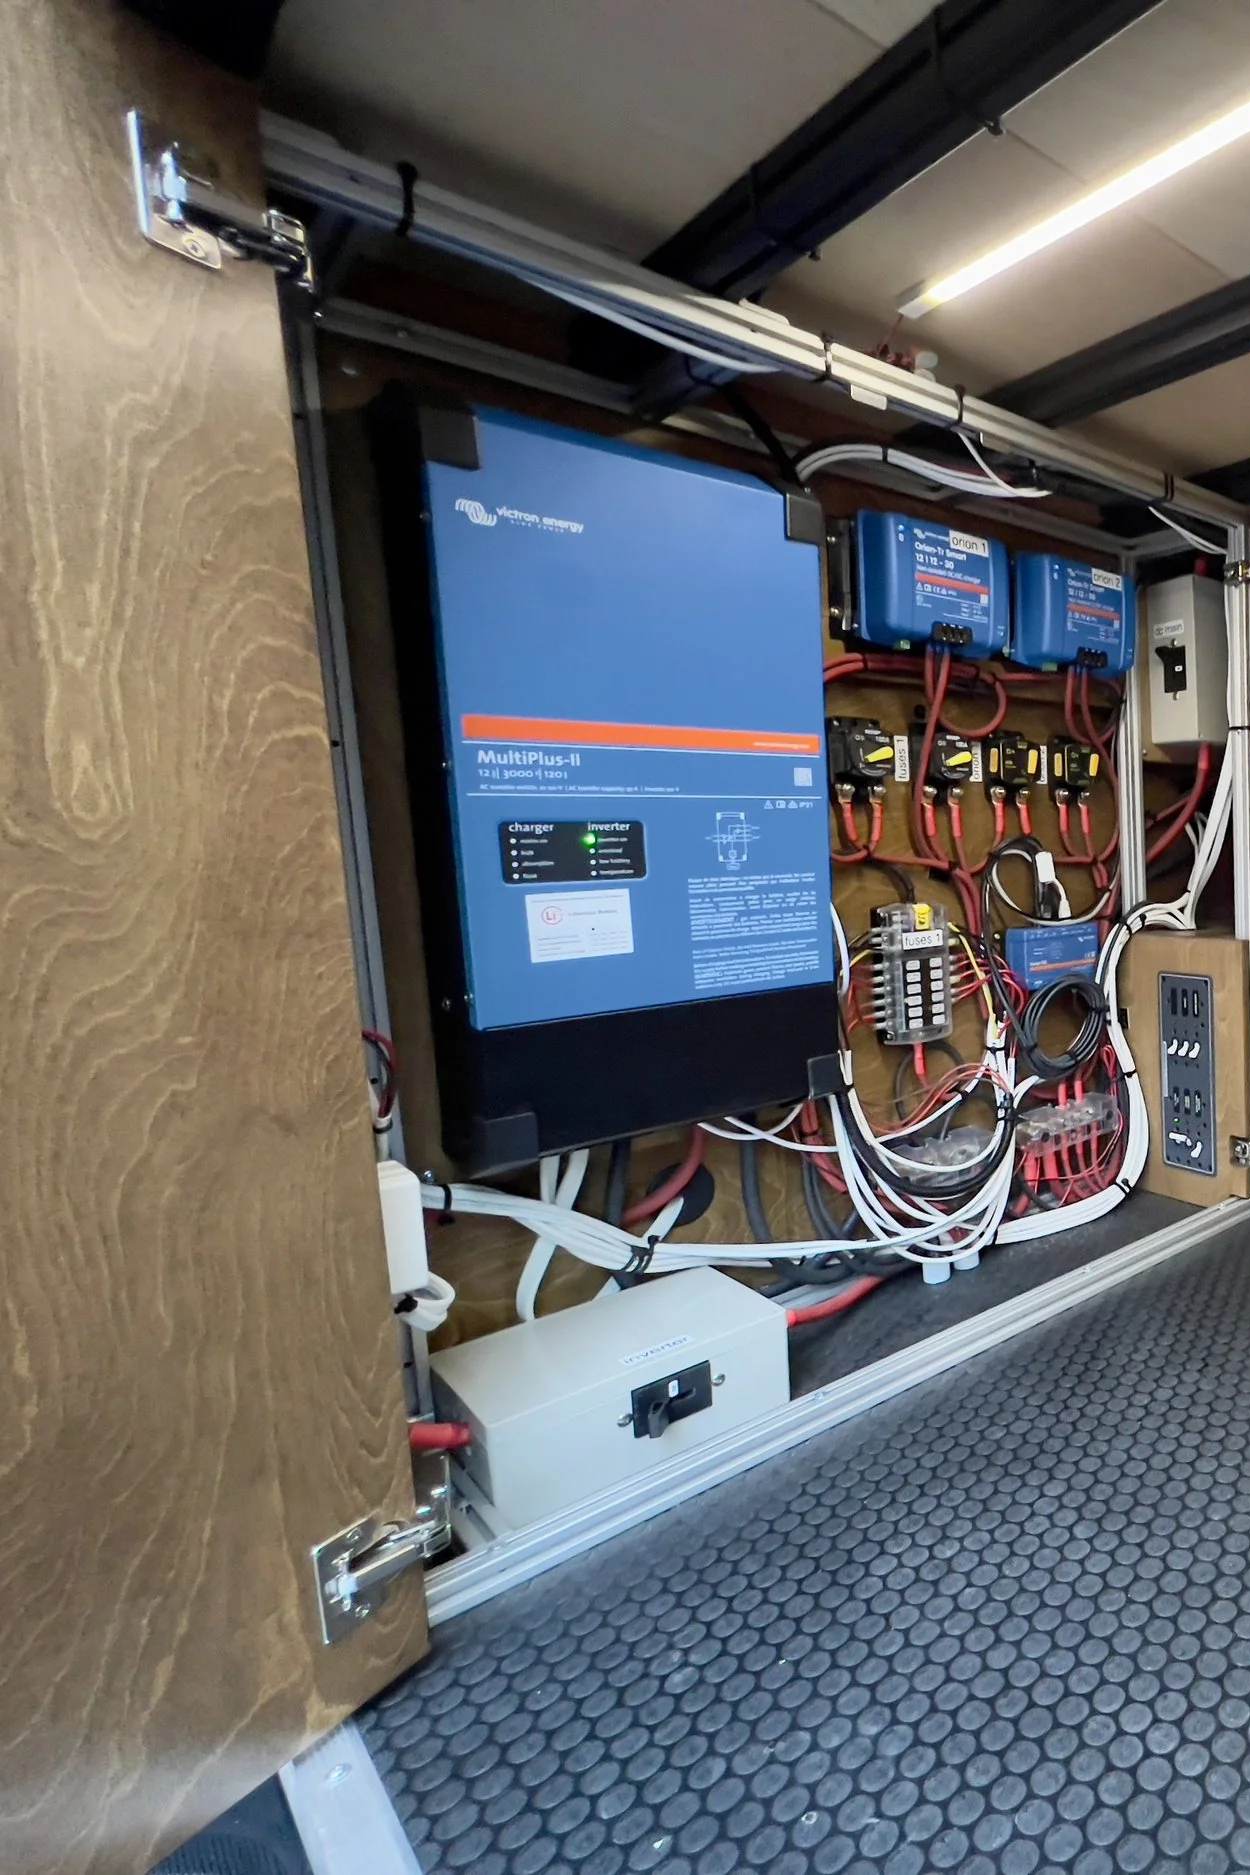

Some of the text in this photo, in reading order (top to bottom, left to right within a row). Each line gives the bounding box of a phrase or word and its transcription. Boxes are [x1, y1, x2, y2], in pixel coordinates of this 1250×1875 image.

[496, 506, 539, 522] victron
[542, 517, 584, 533] energy
[915, 541, 944, 556] Orion-Tr
[951, 536, 978, 550] orion
[981, 542, 986, 553] 1
[915, 553, 924, 563] 12
[930, 556, 938, 566] 12
[1093, 574, 1121, 588] orion 2
[477, 750, 581, 767] MultiPlus-II
[897, 748, 907, 779] fuses
[478, 769, 490, 778] 12
[503, 769, 533, 780] 3000
[544, 770, 562, 779] 120
[508, 822, 631, 835] charger inverter
[905, 933, 940, 946] fuses 1
[624, 1336, 688, 1365] inverter
